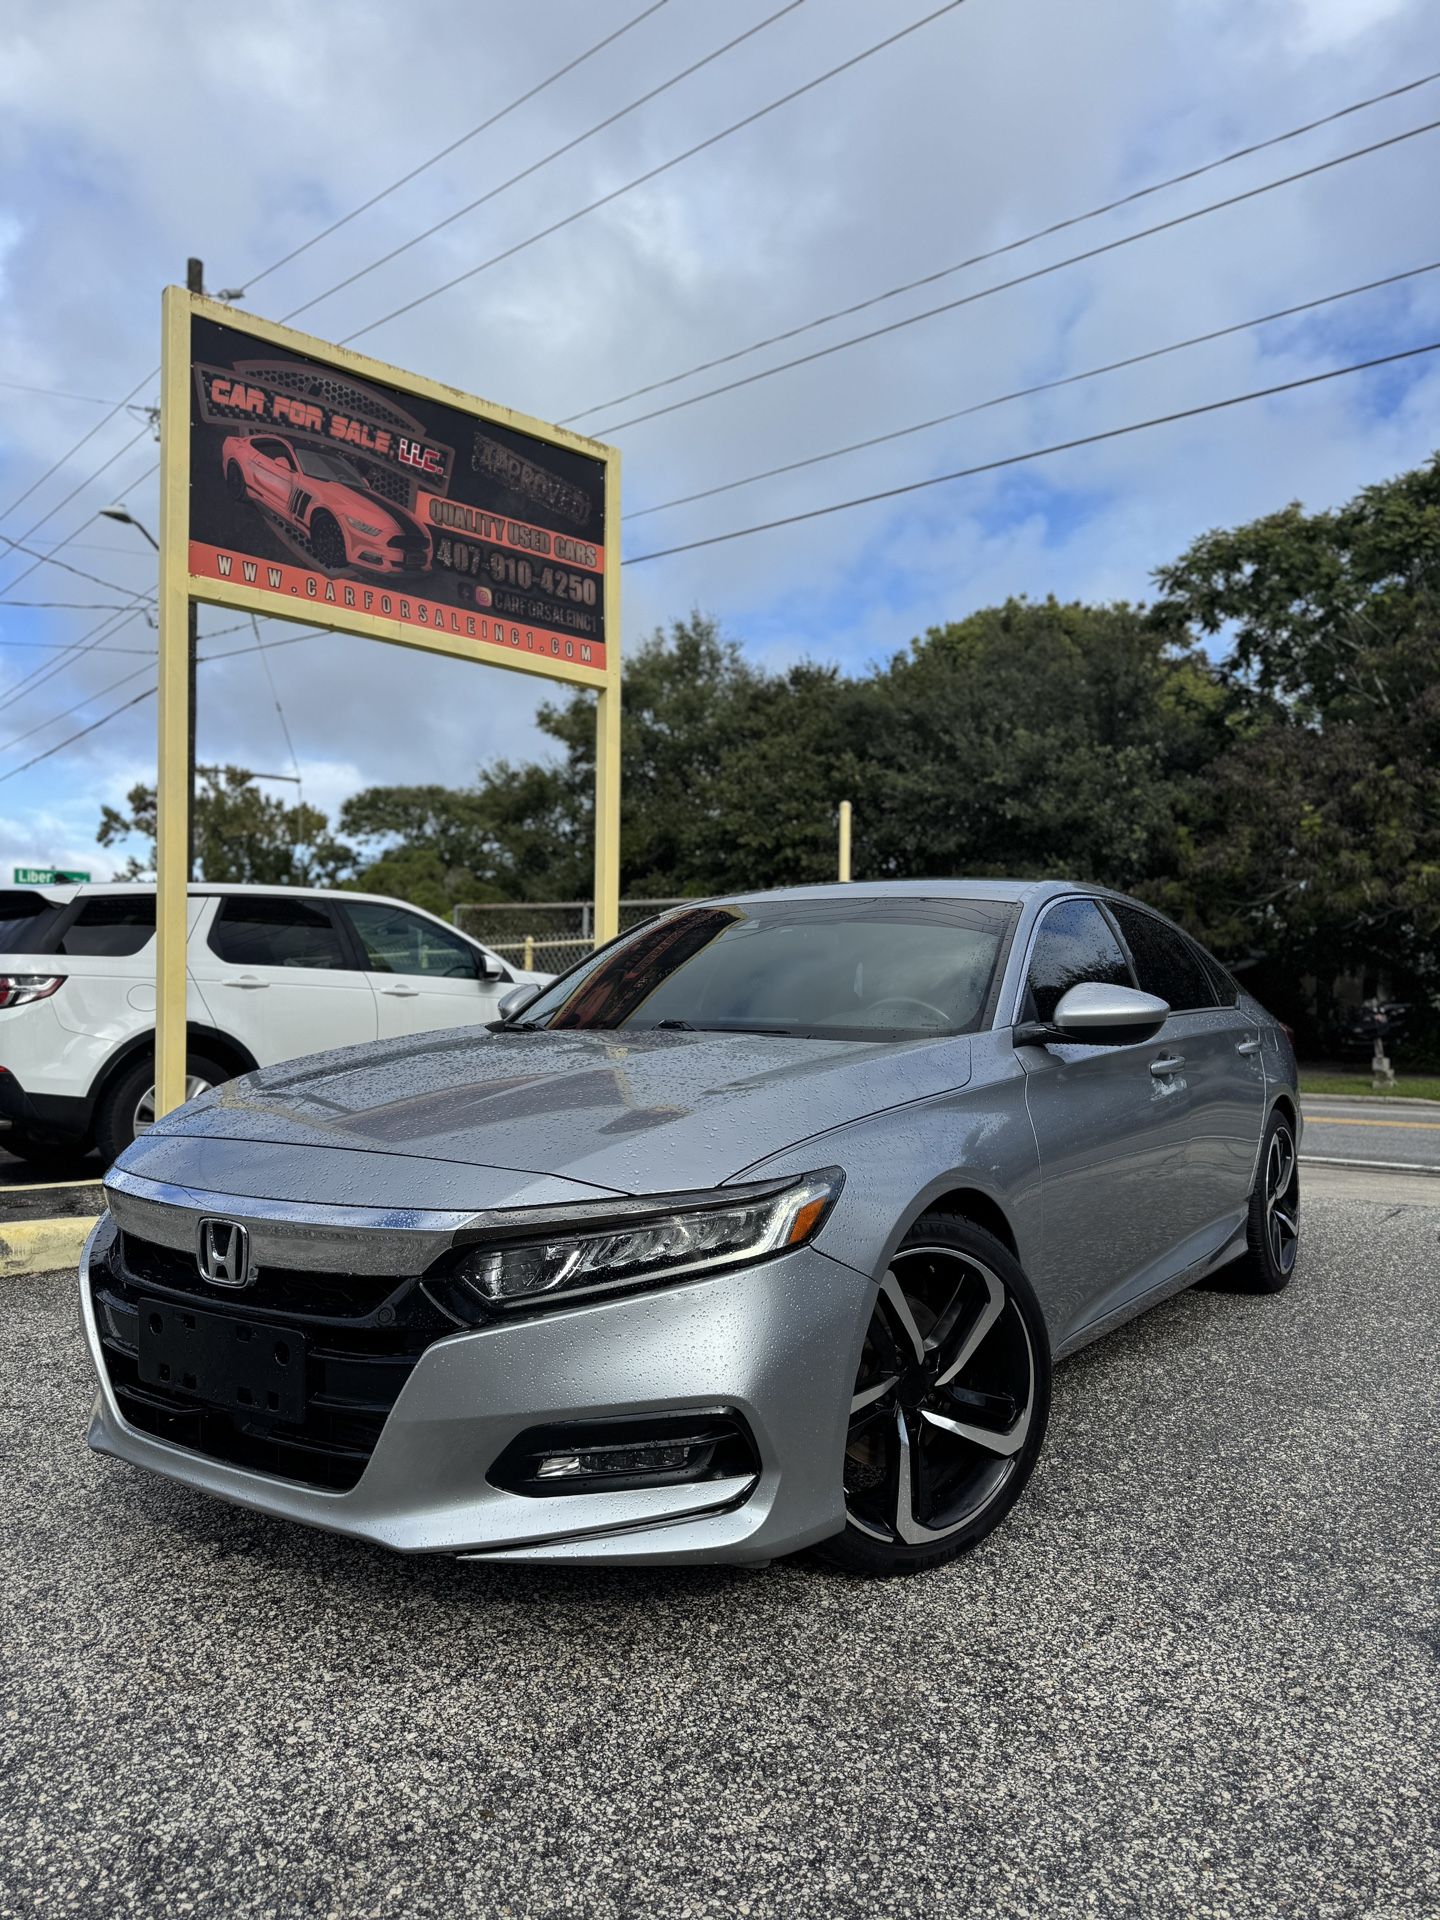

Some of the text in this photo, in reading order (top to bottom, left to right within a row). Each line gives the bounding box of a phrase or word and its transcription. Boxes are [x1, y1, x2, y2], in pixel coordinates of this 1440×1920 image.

[211, 378, 266, 415] CAR
[272, 395, 324, 431] FOR
[329, 415, 392, 454] SALE
[429, 498, 597, 568] QUALITY USED CARS
[436, 537, 597, 606] 407-910-4250
[216, 553, 592, 662] WWW.CARFORSALEINC1.COM
[494, 592, 597, 633] CARFORSALEINC1
[18, 869, 56, 884] Liber
